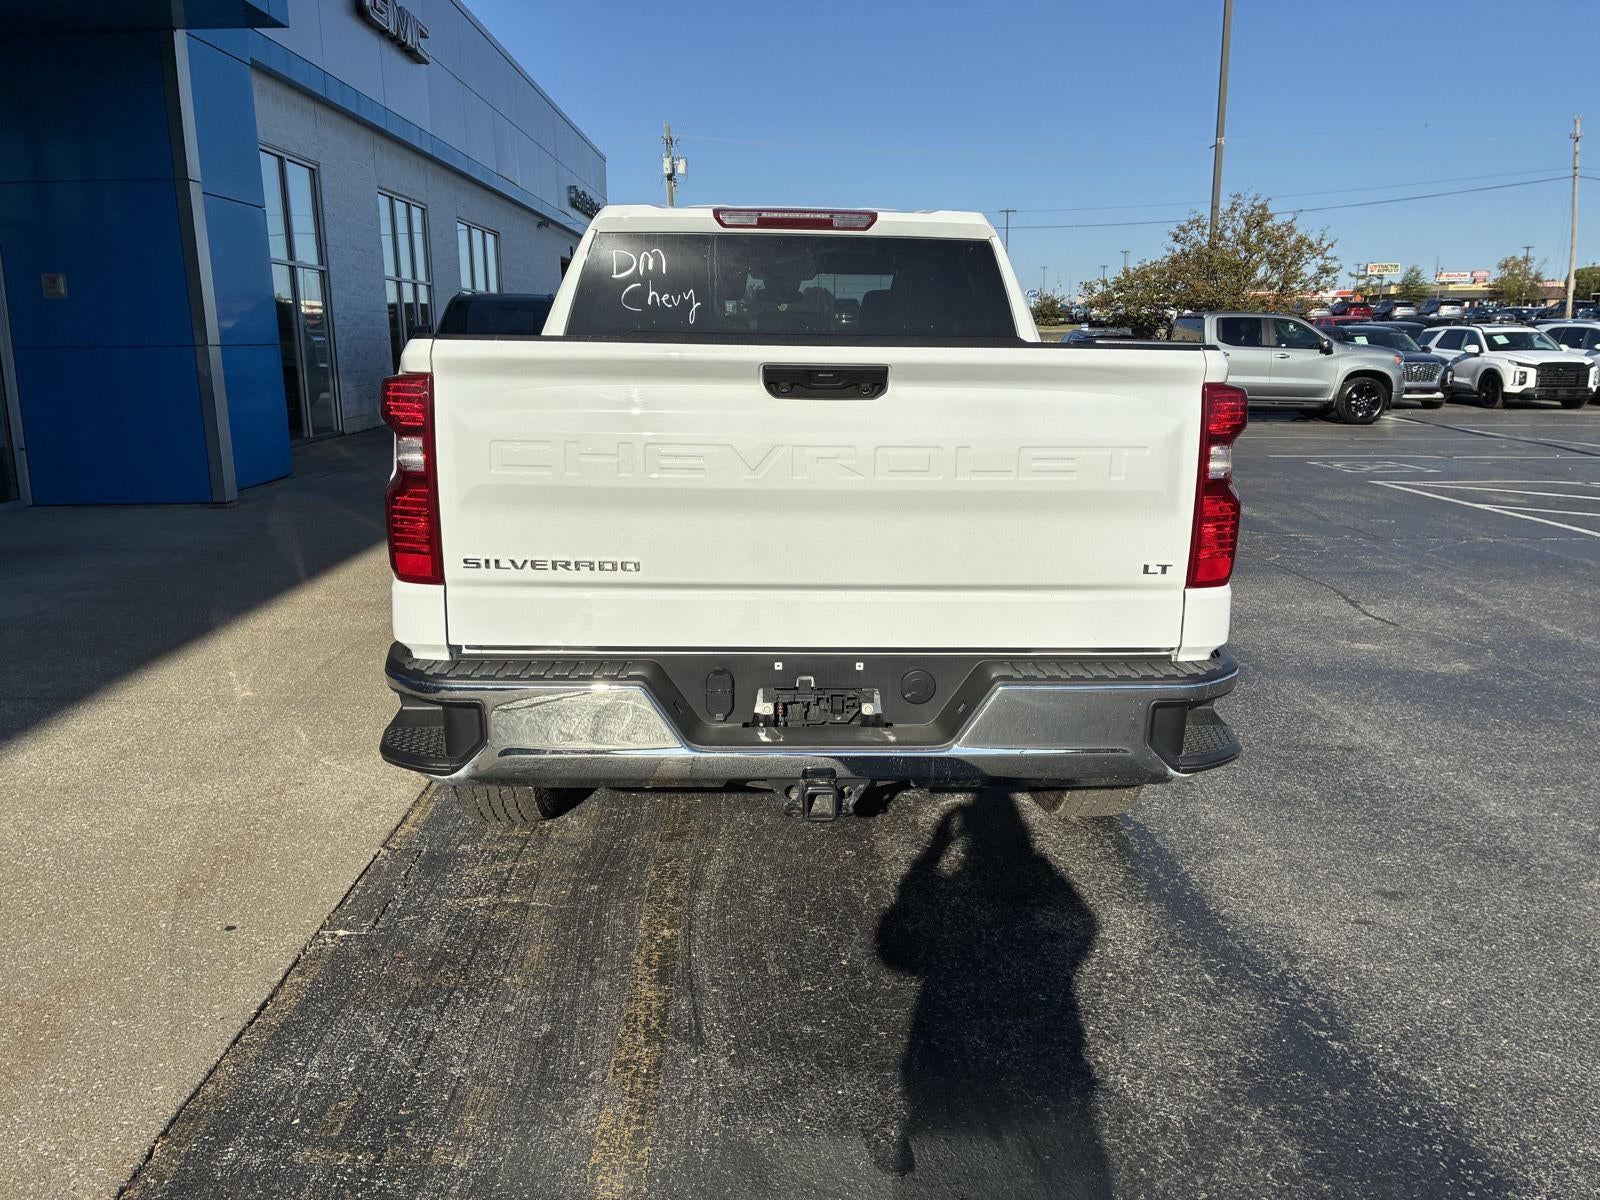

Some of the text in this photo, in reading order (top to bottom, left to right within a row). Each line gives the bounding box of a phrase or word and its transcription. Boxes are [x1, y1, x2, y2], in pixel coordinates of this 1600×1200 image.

[620, 280, 702, 325] Chevy
[488, 439, 1152, 481] CHEVROLET
[462, 557, 641, 573] SILVERADO
[1142, 563, 1173, 575] LT
